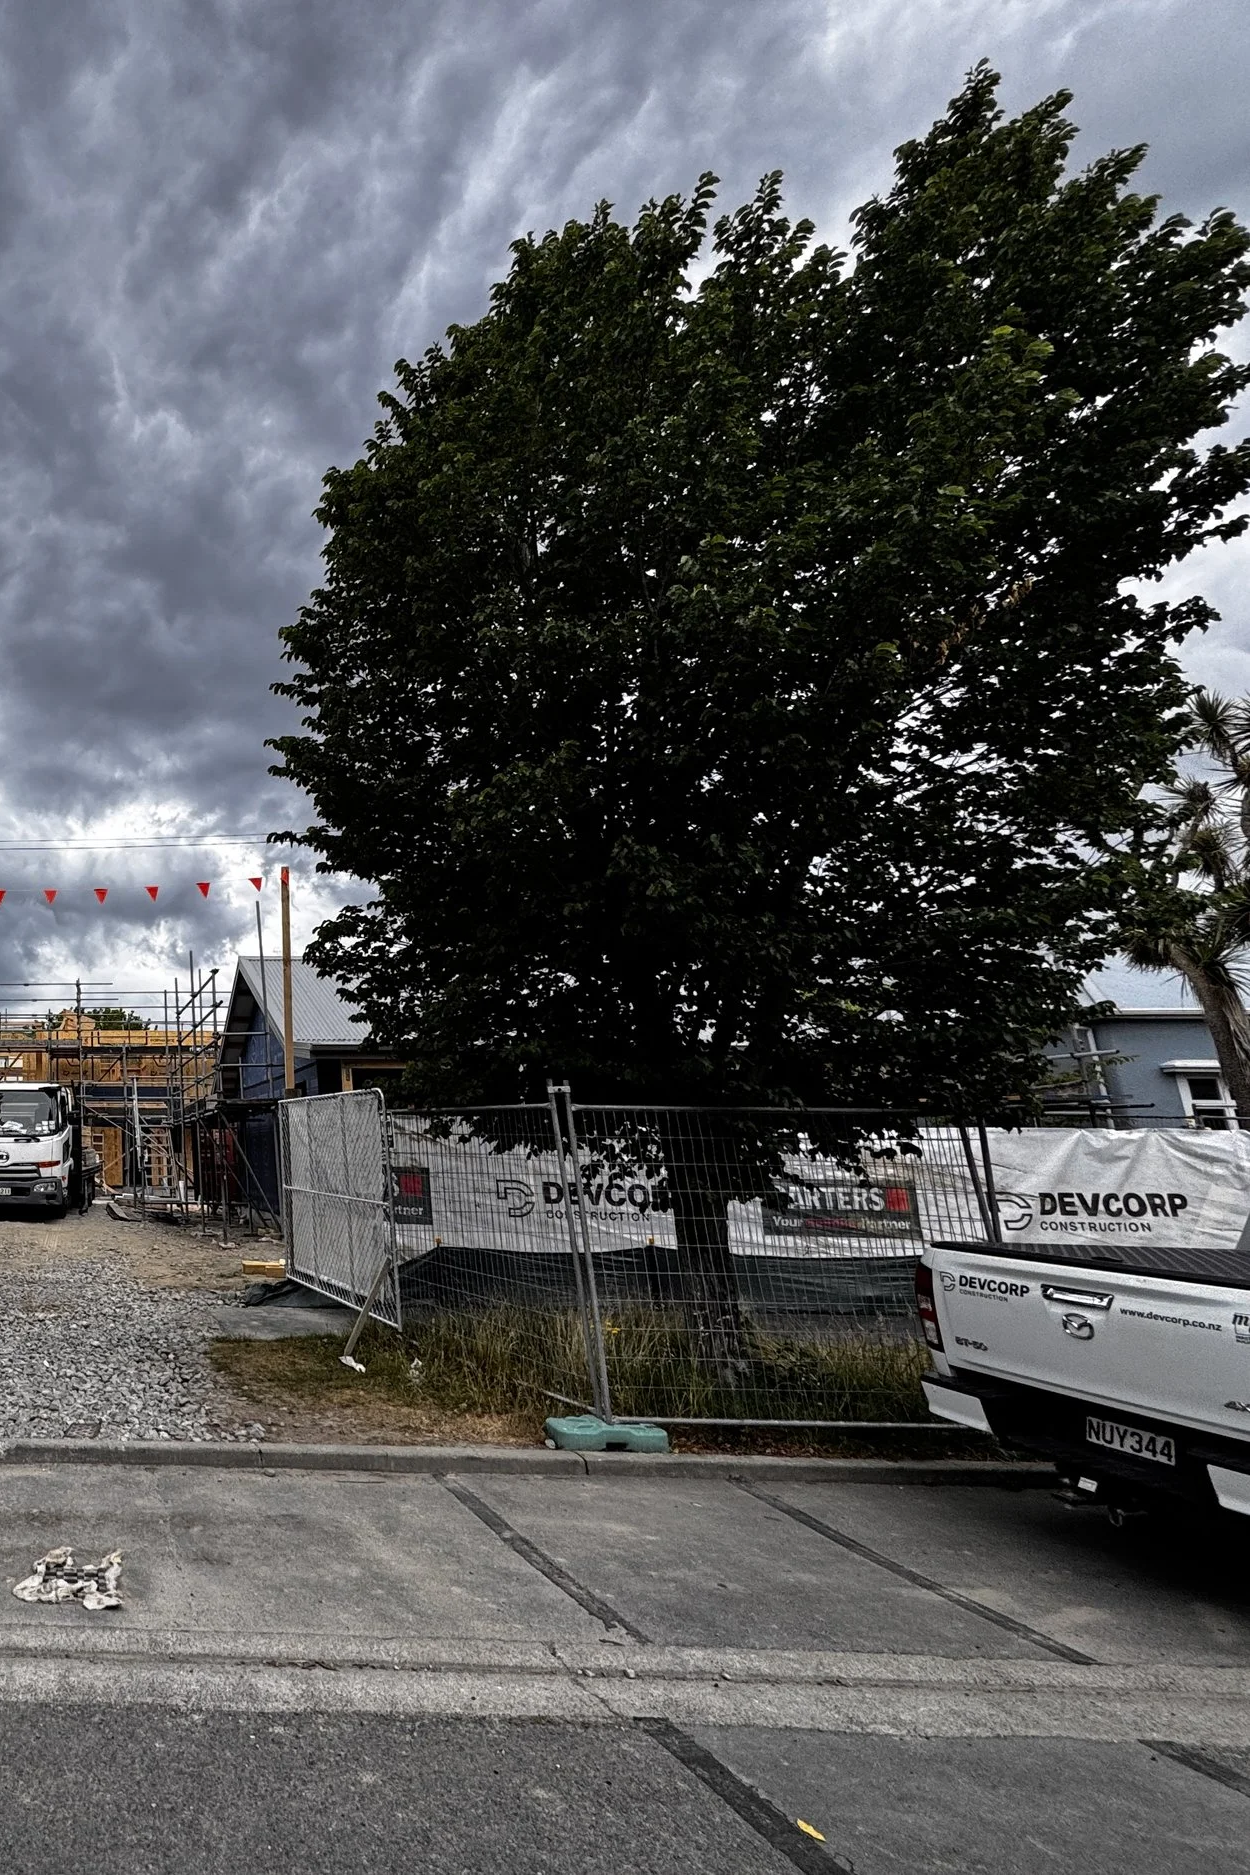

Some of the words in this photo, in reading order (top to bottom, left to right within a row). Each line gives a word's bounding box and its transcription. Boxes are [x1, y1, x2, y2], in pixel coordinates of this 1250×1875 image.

[778, 1186, 885, 1211] ARTERS
[1038, 1193, 1188, 1217] DEVCORP
[1040, 1221, 1152, 1233] CONSTRUCTION
[958, 1275, 1030, 1297] DEVCORP
[959, 1289, 1009, 1302] CONSTRUCTION
[1120, 1308, 1222, 1331] www.devcorp.co.nz
[1088, 1419, 1173, 1463] NUY344
